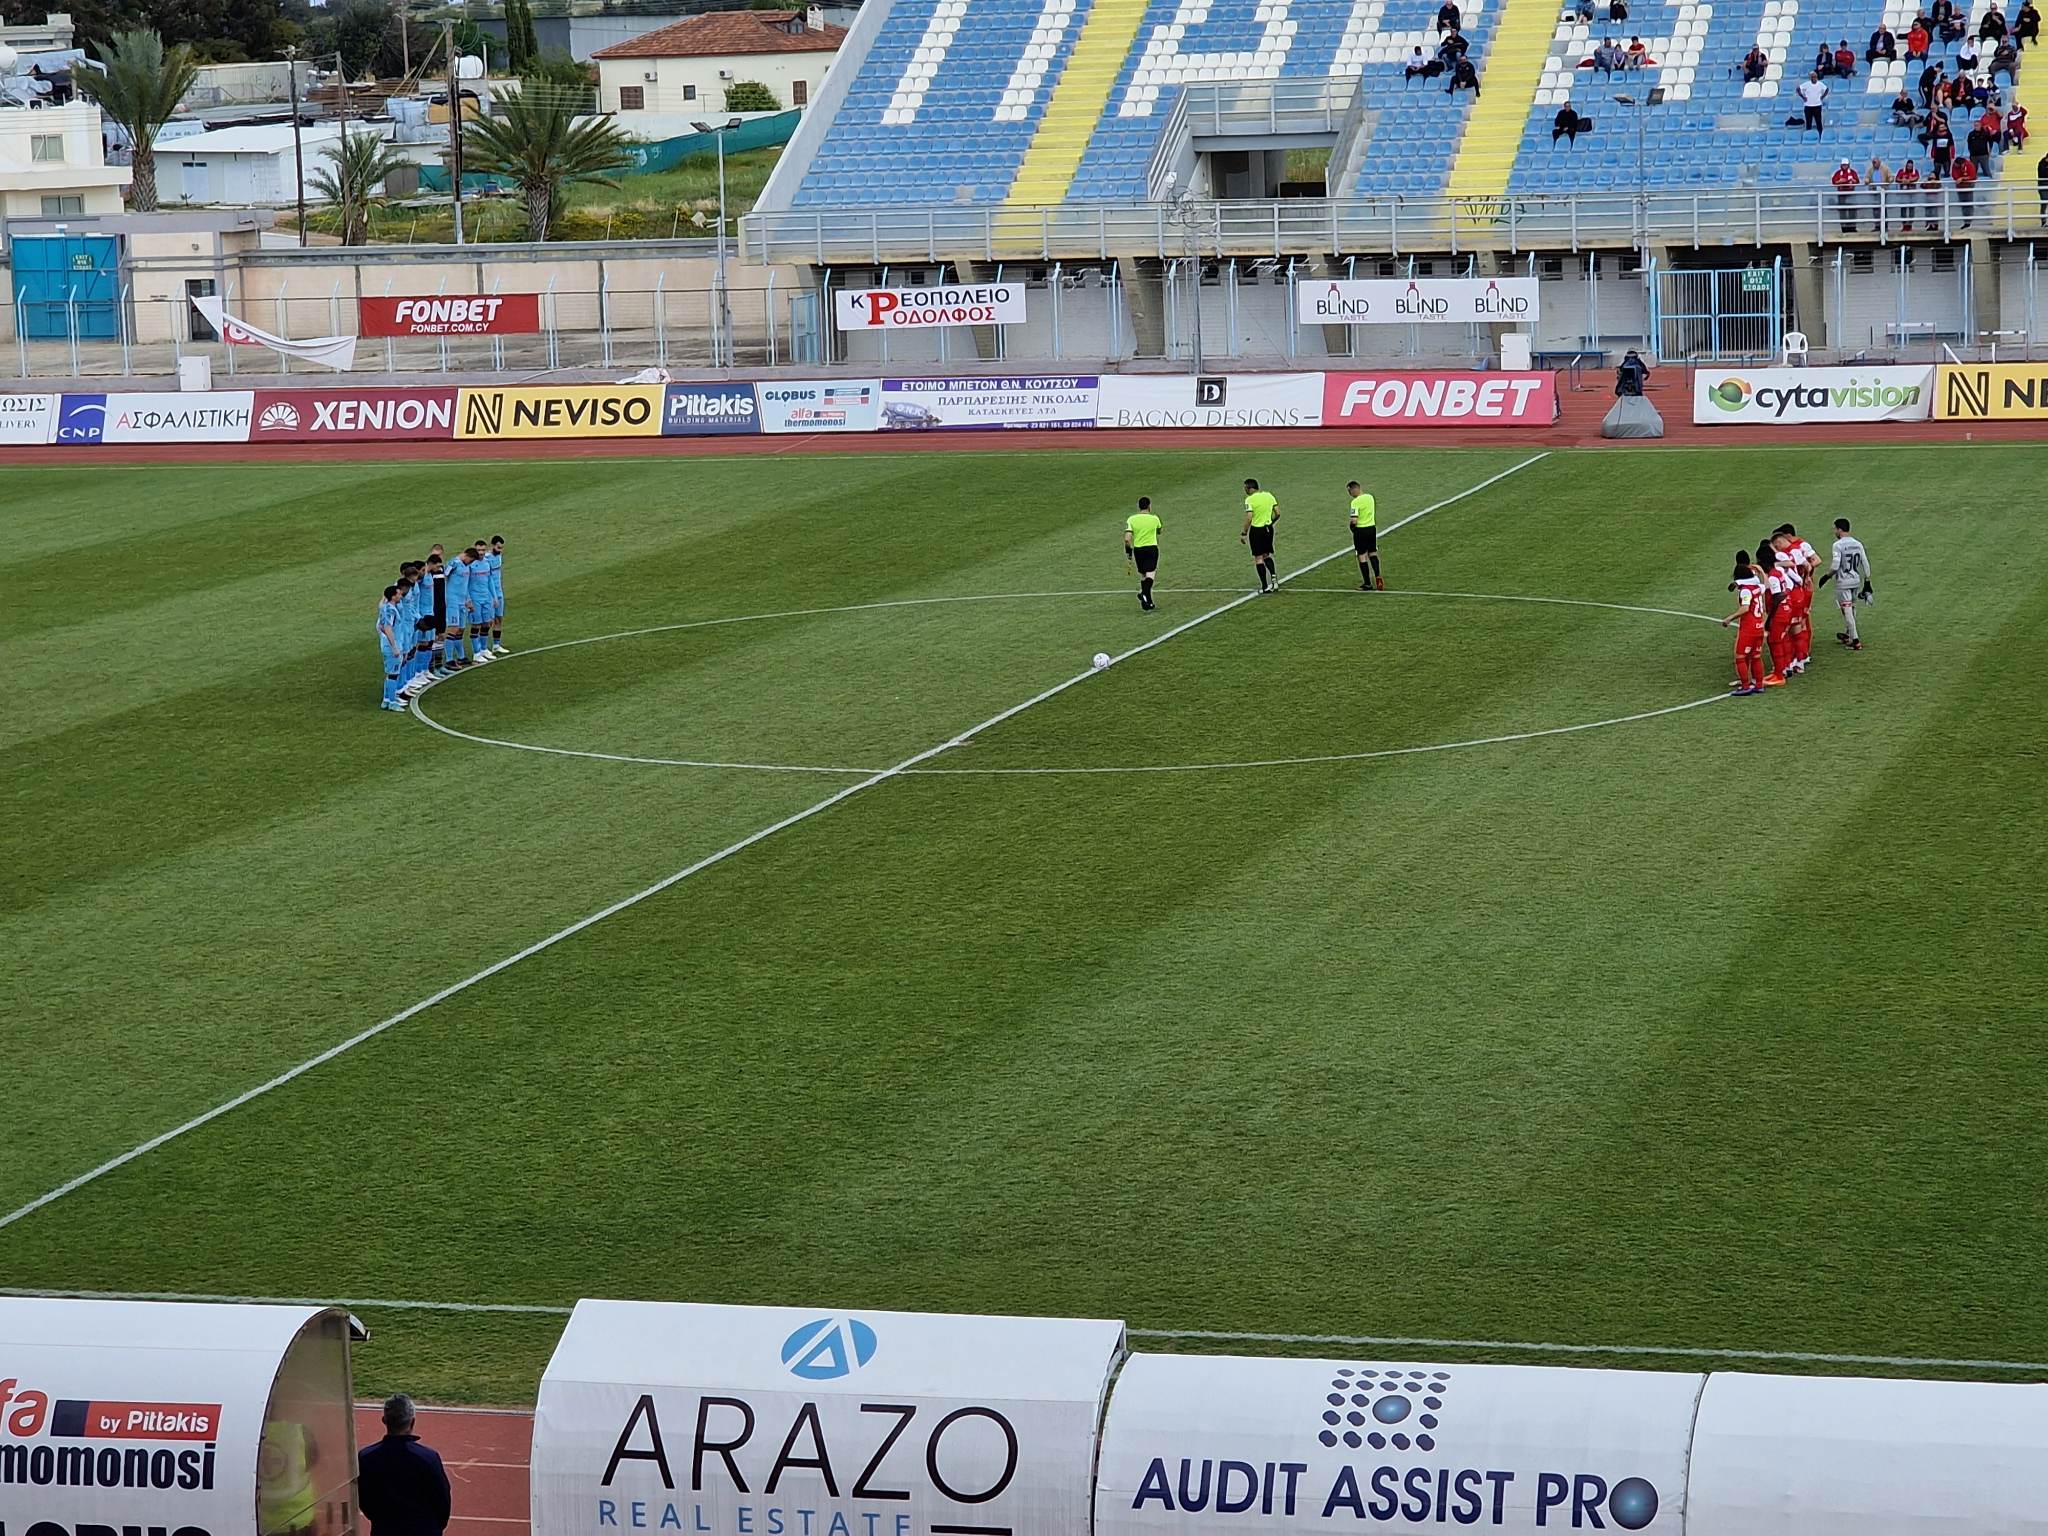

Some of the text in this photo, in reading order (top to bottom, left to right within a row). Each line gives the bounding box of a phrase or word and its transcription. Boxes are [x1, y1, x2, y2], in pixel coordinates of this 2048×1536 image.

[395, 298, 503, 323] FONBET
[410, 323, 490, 333] FONBET.COM.CY
[901, 381, 946, 391] ΕΤΟΙΜΟ
[949, 380, 998, 390] ΜΠΕΤΟΝ
[1025, 378, 1079, 389] ΚΟΥΤΣΟΥ
[669, 393, 754, 416] Pittakis
[765, 390, 816, 402] GLOBUS
[1032, 394, 1089, 405] ΝΙΚΟΛΑΣ
[1339, 379, 1541, 417] FONBET
[1755, 378, 1921, 417] cytavision
[116, 408, 249, 429] ΑΣΦΑΛΙΣΤΙΚΗ
[309, 398, 452, 431] XENION
[513, 397, 651, 427] NEVISO
[668, 415, 751, 424] BUILDING MATERIALS
[784, 418, 846, 427] thermomonosi
[791, 408, 813, 419] alfa
[1118, 407, 1299, 427] BAGNO DESIGNS
[59, 427, 100, 438] CNP
[100, 1410, 209, 1433] by Pittakis
[600, 1394, 1018, 1504] ARAZO
[1131, 1457, 1308, 1517] AUDIT
[1321, 1465, 1515, 1526] ASSIST
[599, 1499, 911, 1536] REAL ESTATE
